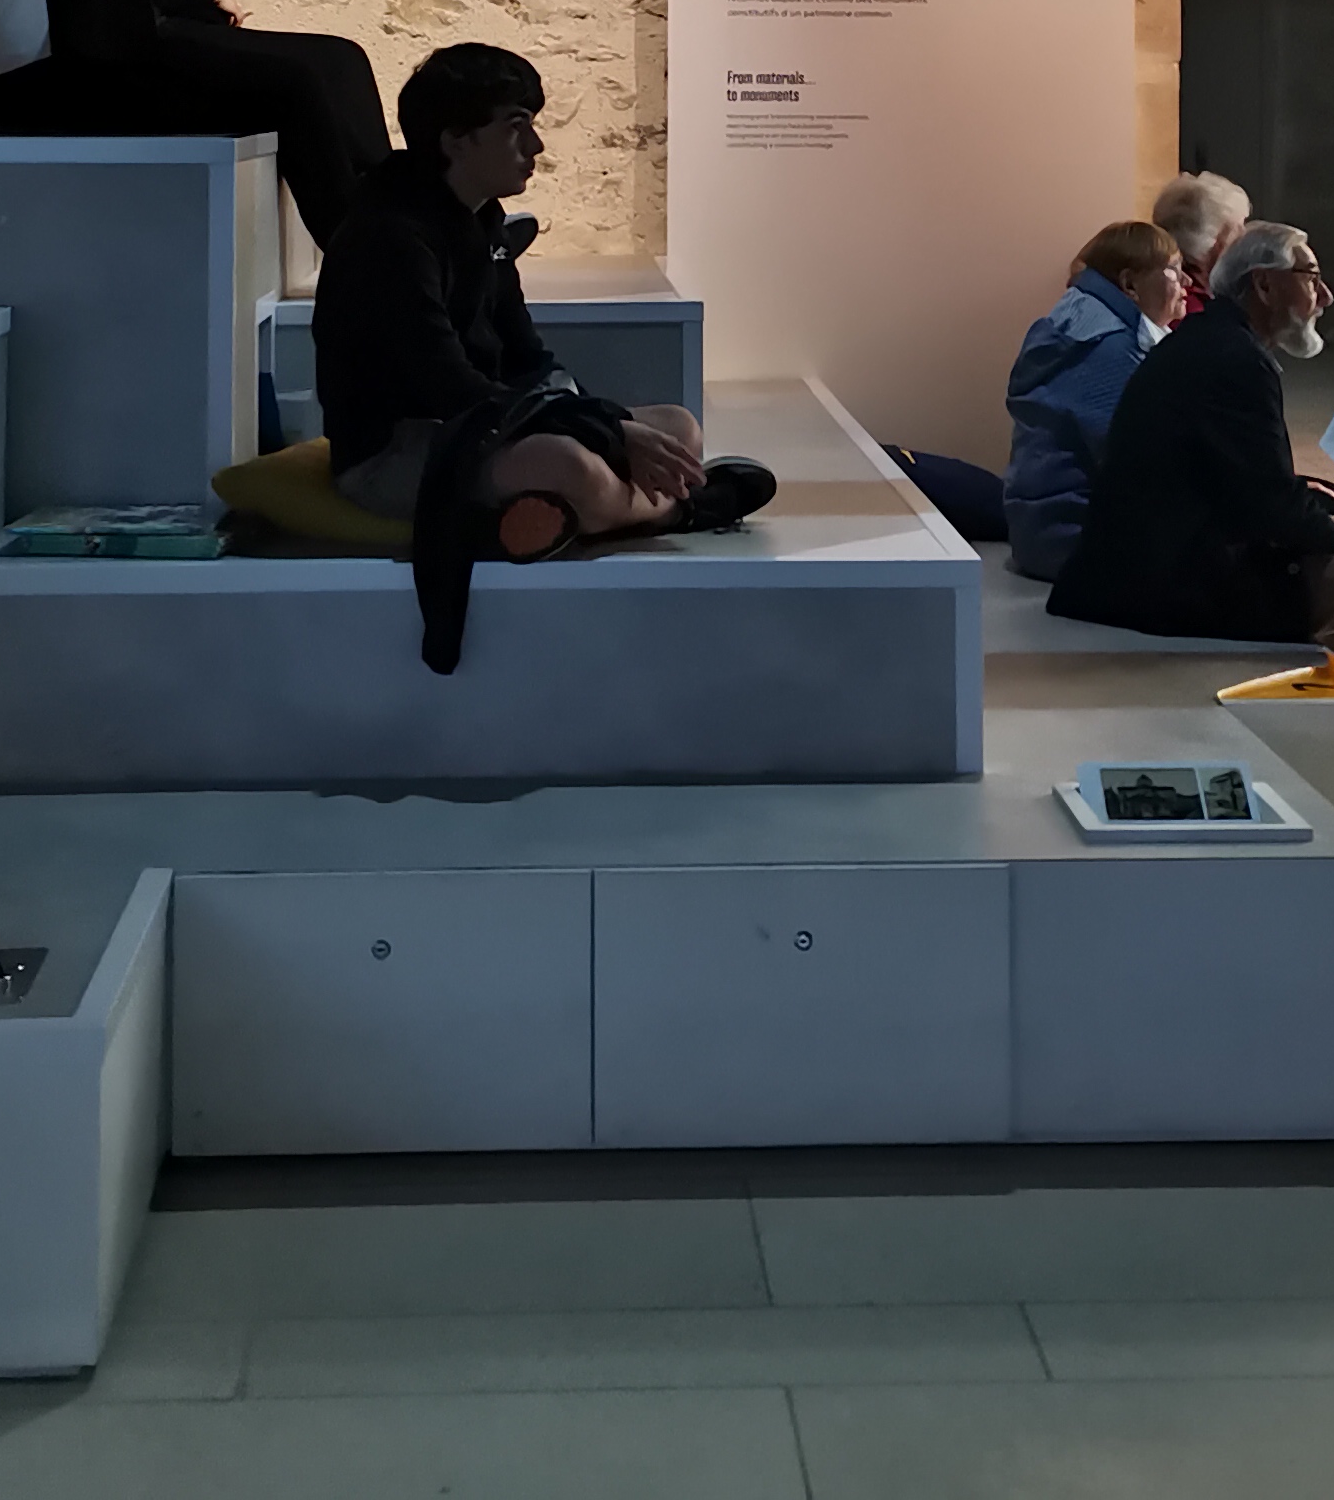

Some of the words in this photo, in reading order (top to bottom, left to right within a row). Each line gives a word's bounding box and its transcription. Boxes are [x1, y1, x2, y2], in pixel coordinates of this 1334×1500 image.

[726, 69, 754, 86] From
[726, 88, 738, 102] to
[740, 88, 800, 103] monuments
